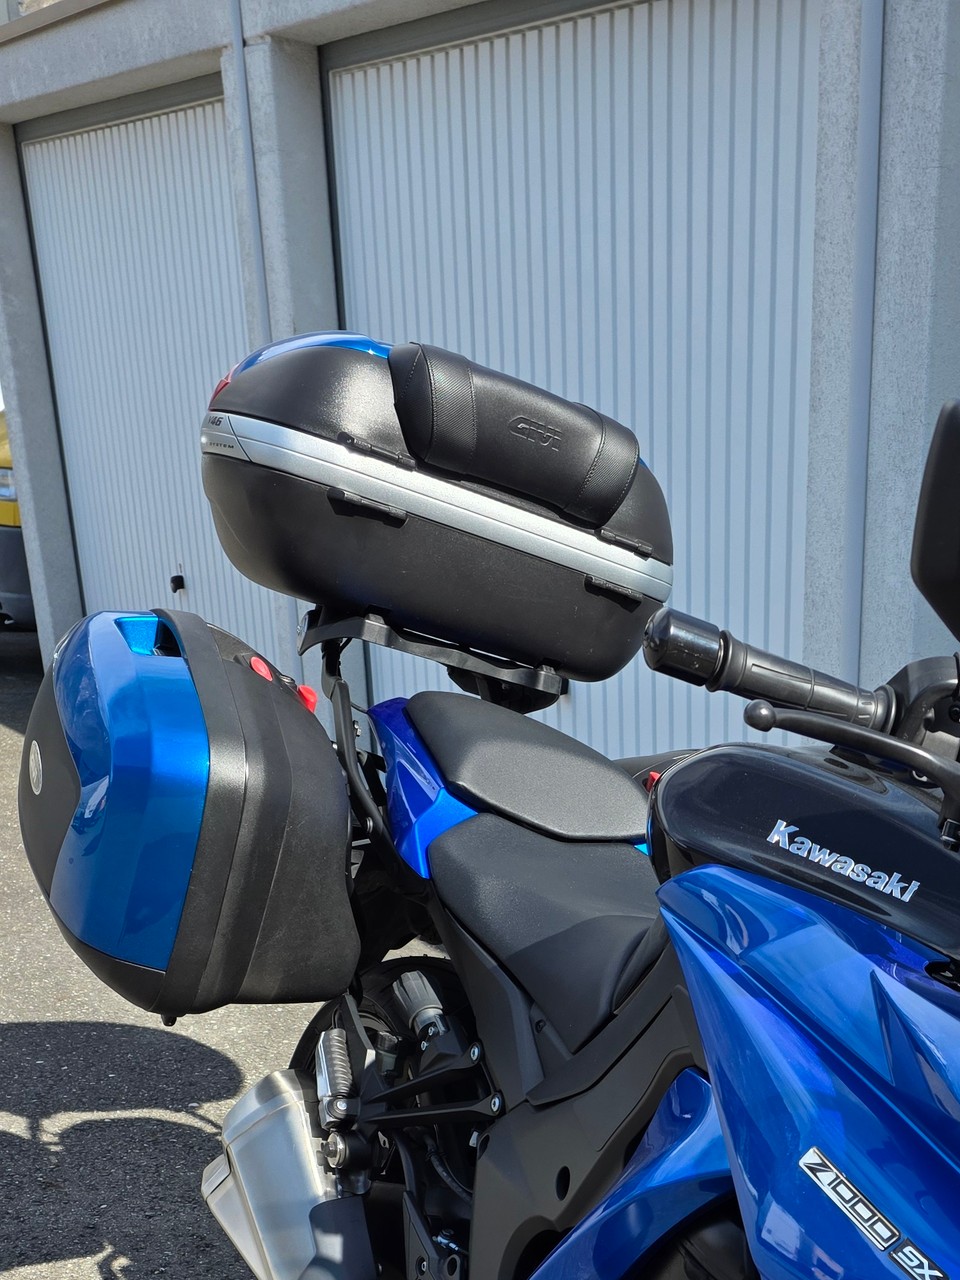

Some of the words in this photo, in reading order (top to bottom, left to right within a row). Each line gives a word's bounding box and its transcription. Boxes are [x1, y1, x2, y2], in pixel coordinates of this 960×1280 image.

[508, 415, 562, 452] GIVI
[766, 819, 920, 903] Kawasaki
[802, 1149, 897, 1247] Z1000
